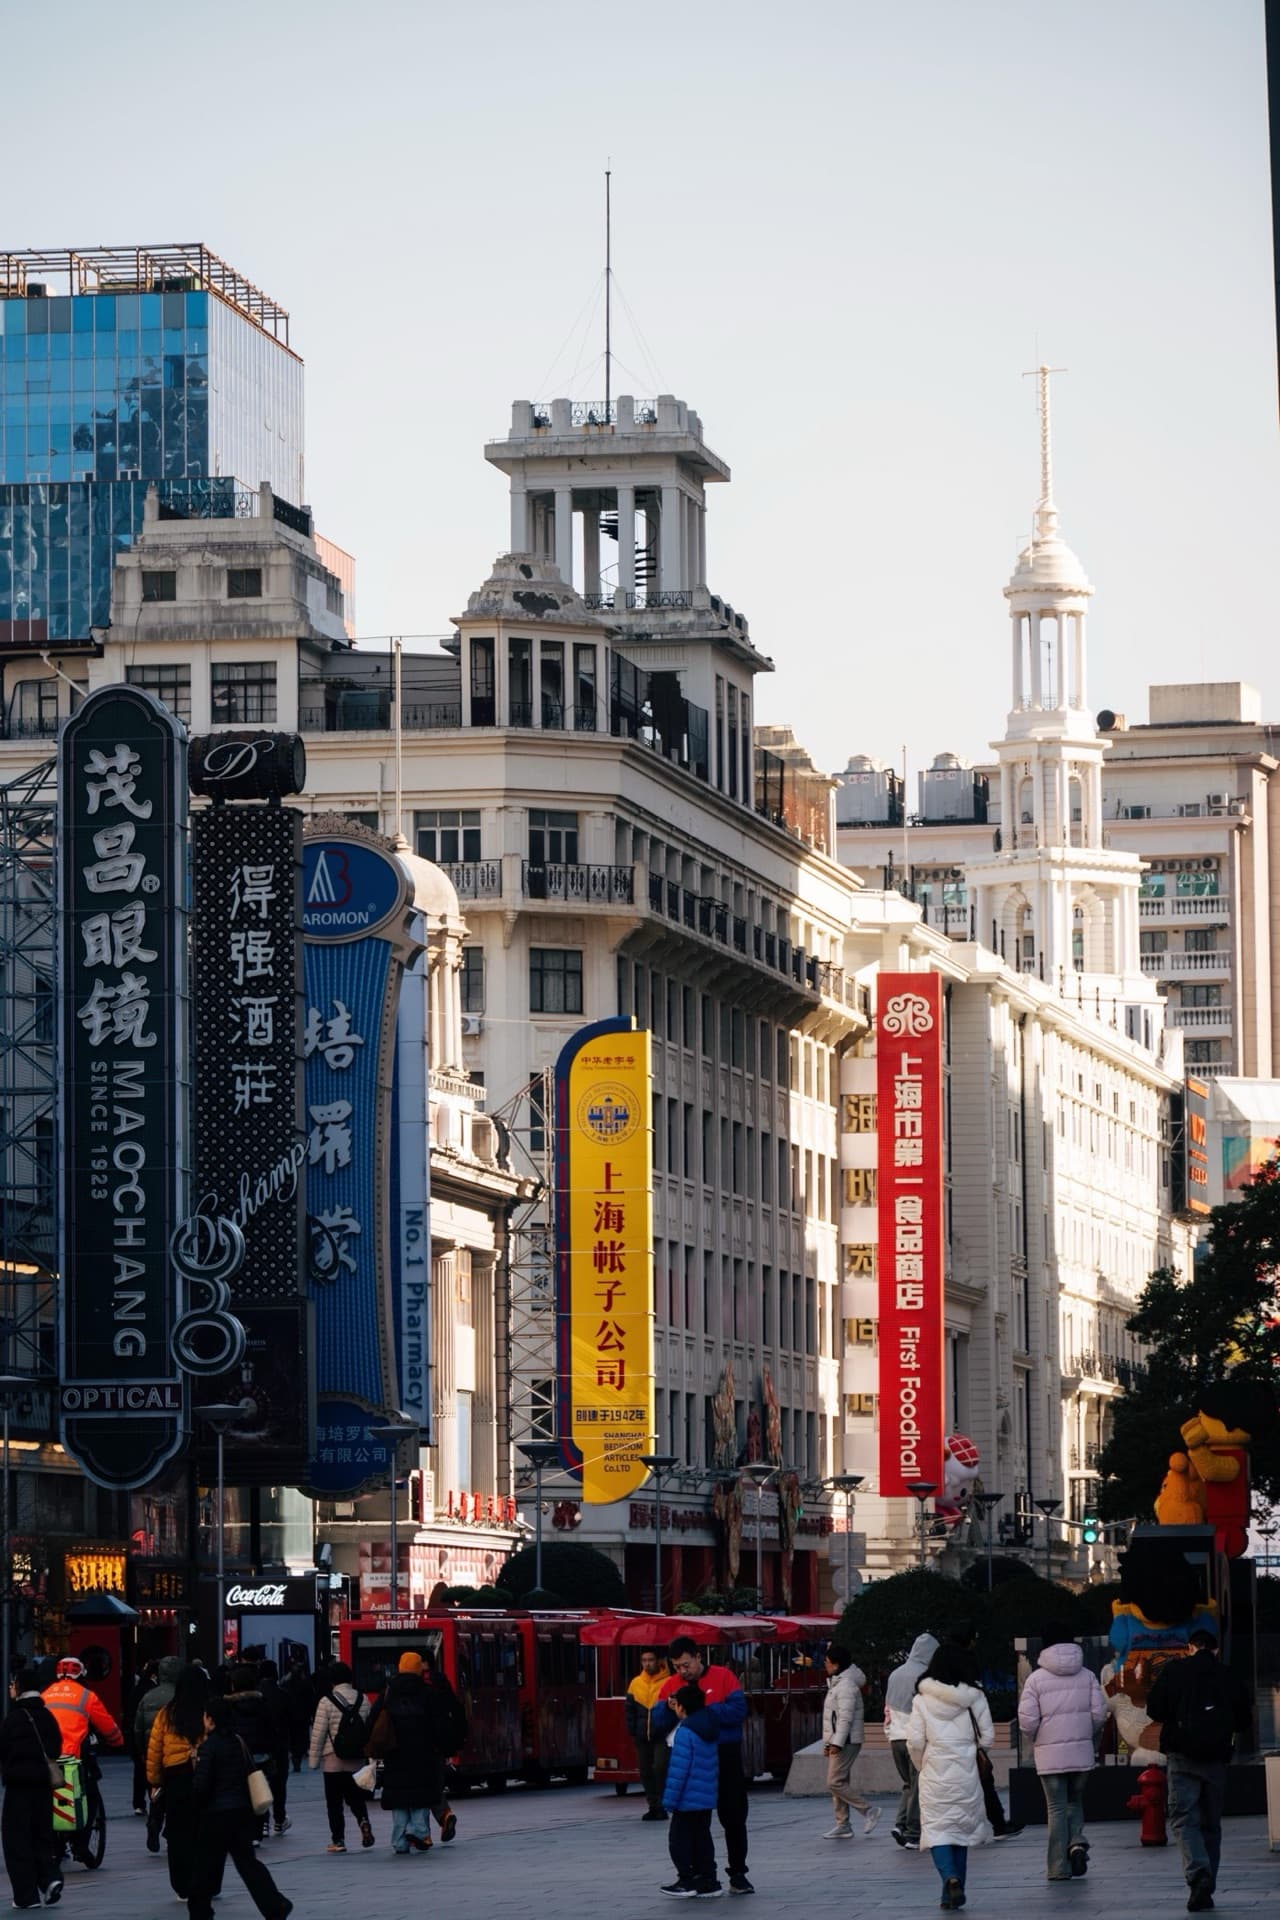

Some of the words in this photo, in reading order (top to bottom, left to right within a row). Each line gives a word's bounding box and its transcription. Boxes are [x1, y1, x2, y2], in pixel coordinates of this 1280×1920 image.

[77, 743, 159, 1049] 茂昌眼镜
[580, 1055, 636, 1066] 中华老字号
[90, 1060, 108, 1133] SINCE
[90, 1145, 108, 1201] 1923
[893, 1052, 925, 1311] 上海市第一食品商店
[112, 1059, 147, 1358] MAOCHANG
[405, 1210, 424, 1268] No.1
[593, 1161, 627, 1392] 上海帐子公司
[405, 1282, 425, 1410] Pharmacy
[899, 1326, 921, 1369] First
[62, 1387, 180, 1410] OPTICAL
[575, 1409, 646, 1422] 创建于1942年
[899, 1375, 922, 1478] Foodhall
[603, 1454, 640, 1462] ARTICLES
[226, 1584, 289, 1607] Coca-Cola
[376, 1620, 402, 1630] ASTRO
[403, 1619, 420, 1630] BOY
